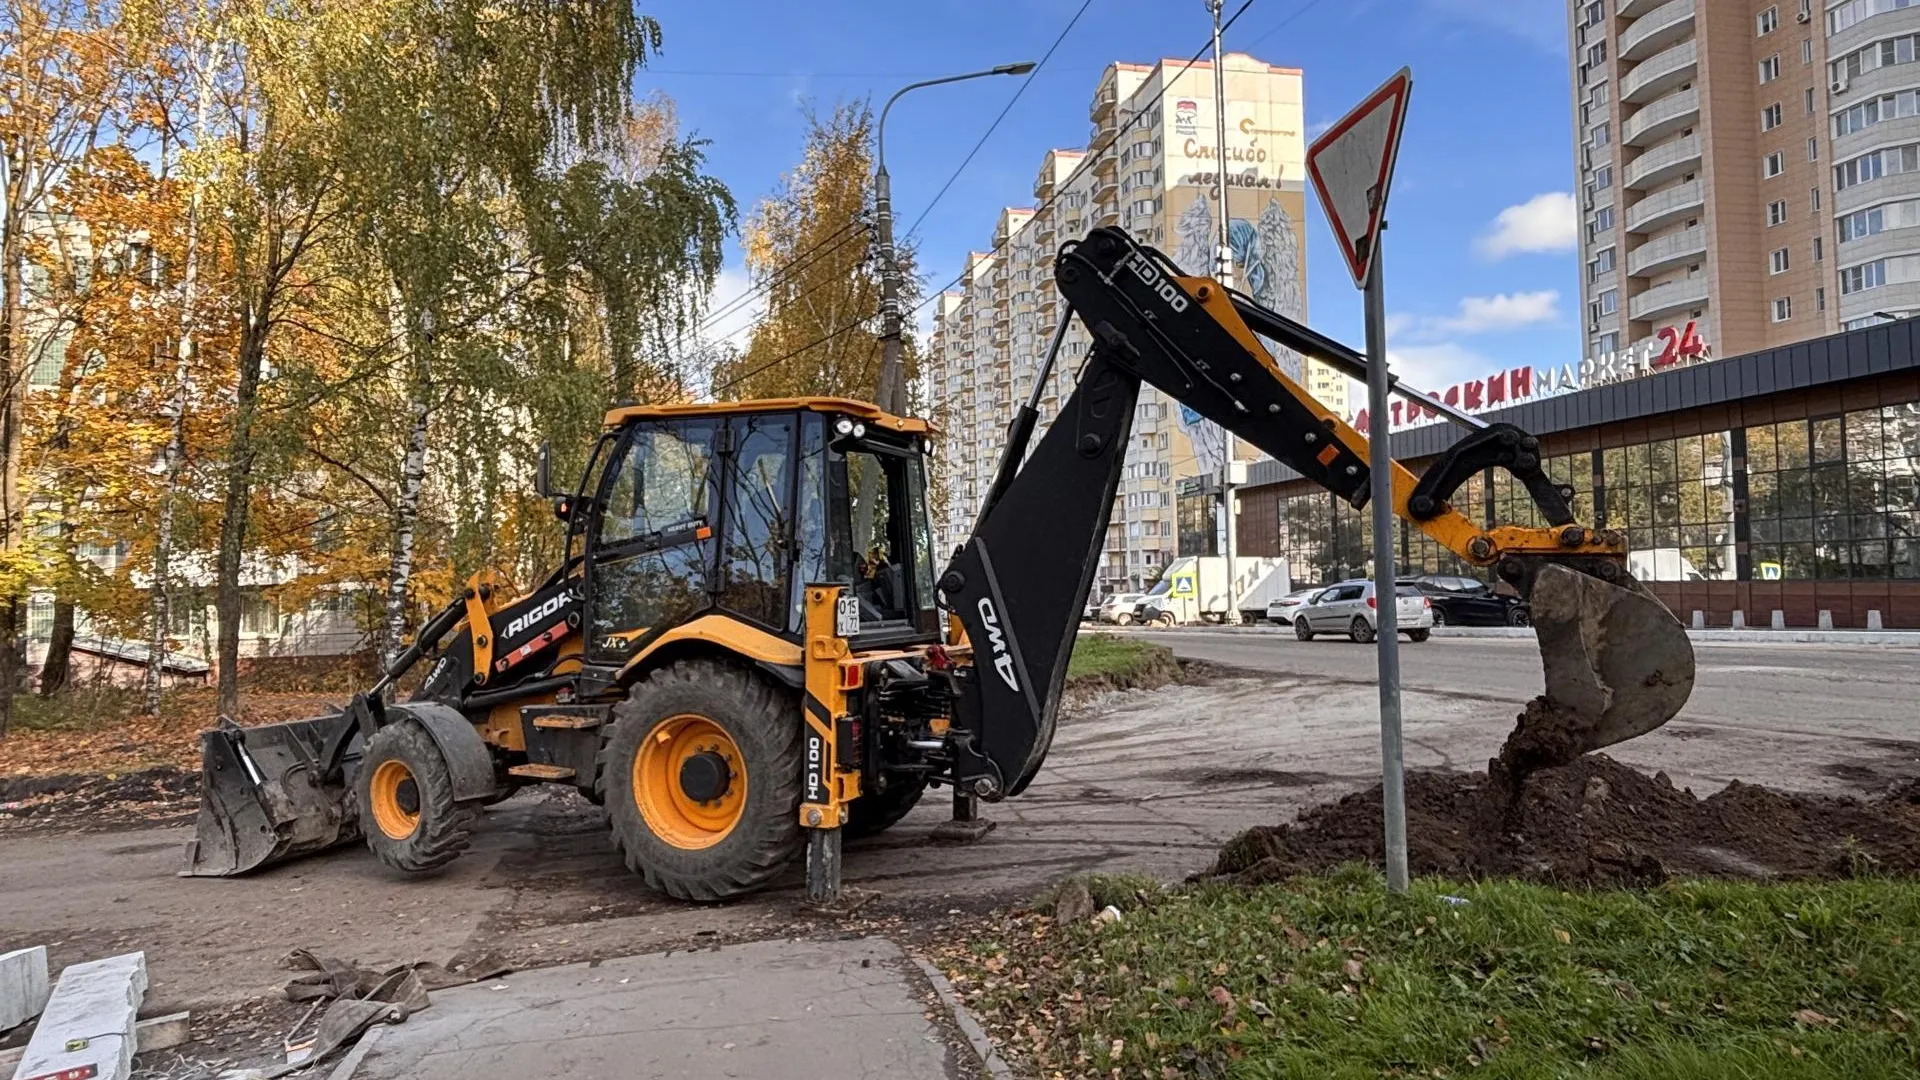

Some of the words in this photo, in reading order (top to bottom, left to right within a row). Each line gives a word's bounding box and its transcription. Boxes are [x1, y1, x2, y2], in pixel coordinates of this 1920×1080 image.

[1536, 341, 1653, 393] МАРКЕТ
[1656, 320, 1704, 366] 24
[424, 656, 447, 690] 4WD
[978, 597, 1020, 692] 4WD
